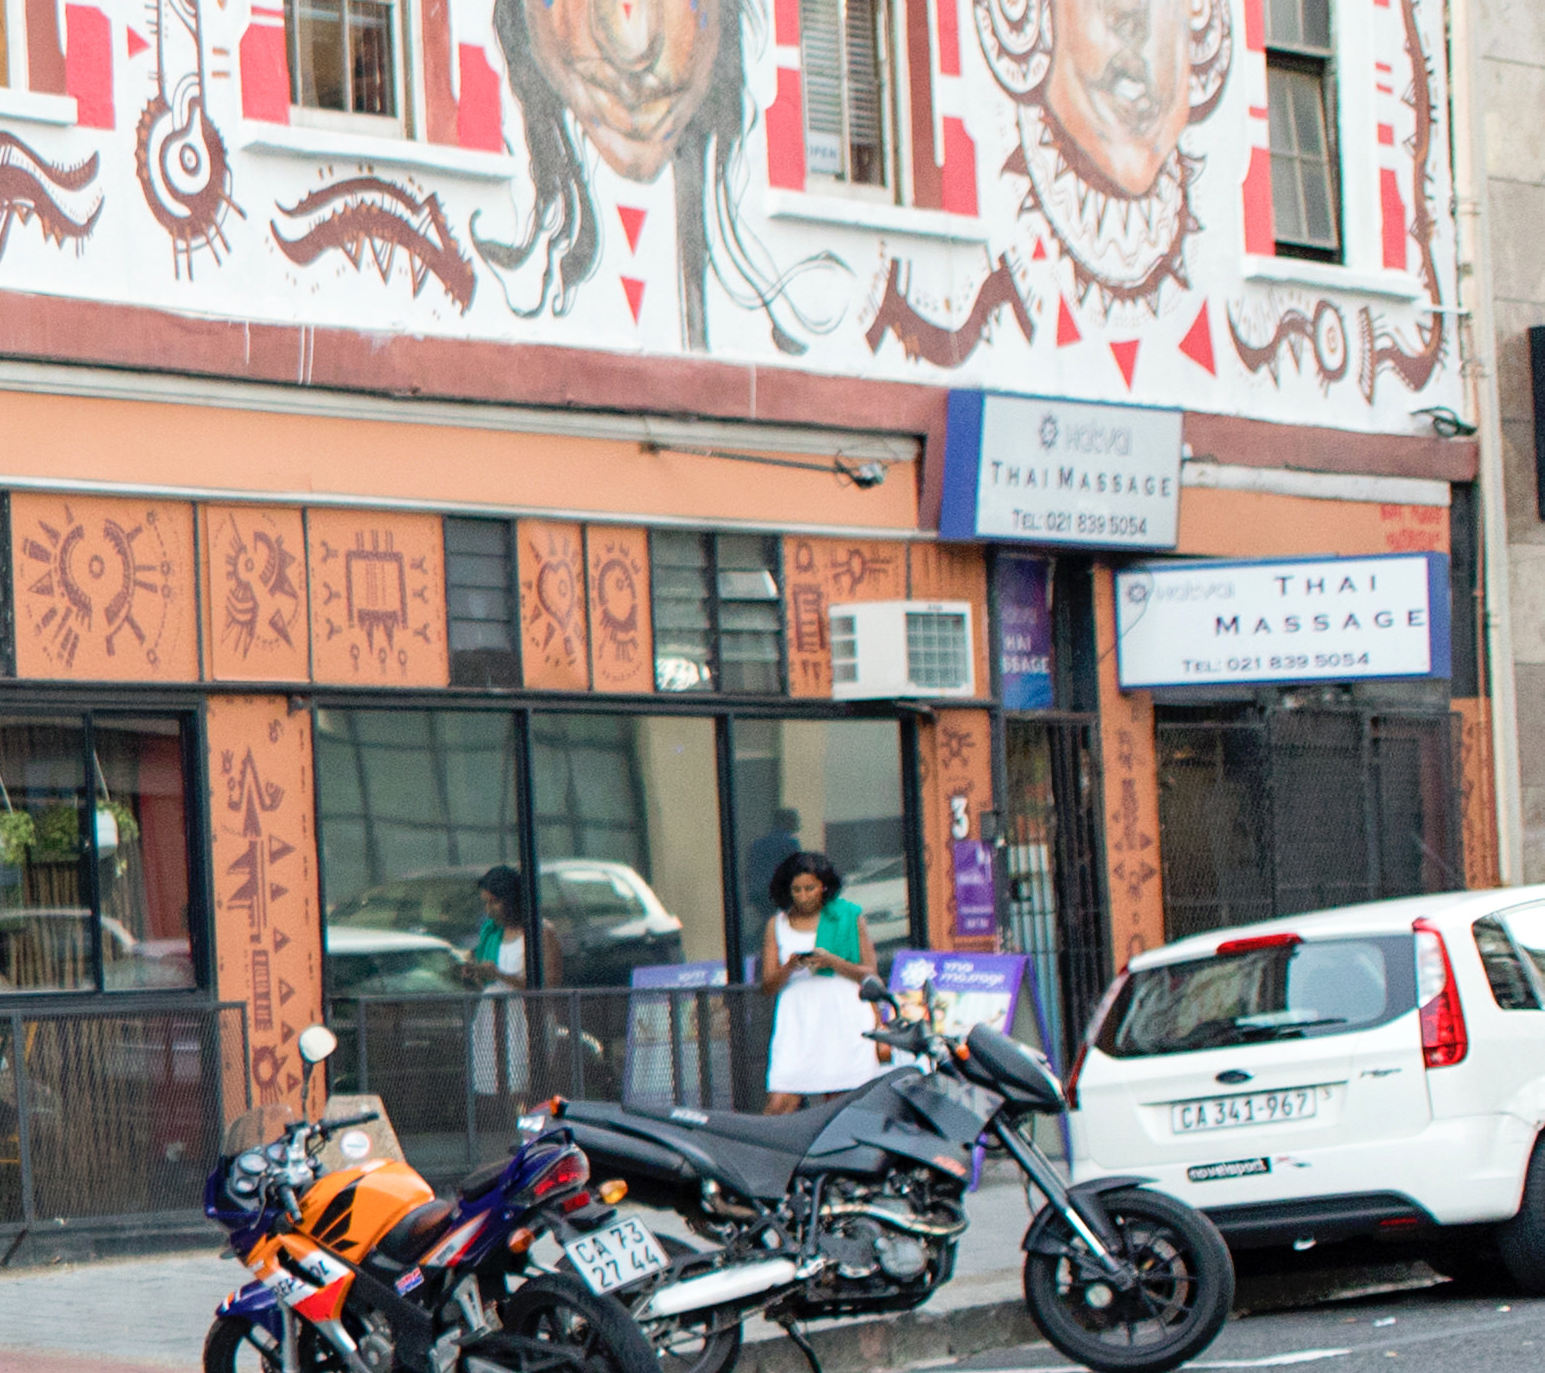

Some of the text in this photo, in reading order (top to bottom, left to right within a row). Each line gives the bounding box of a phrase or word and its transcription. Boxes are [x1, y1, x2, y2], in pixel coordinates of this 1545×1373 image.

[991, 461, 1171, 497] THAI MASSAGE
[1047, 512, 1072, 531] 021
[1077, 513, 1106, 534] 839
[1108, 514, 1147, 535] 5054
[1274, 574, 1377, 597] THAI
[1215, 609, 1425, 636] MASSAGE
[1227, 657, 1261, 672] 021
[1270, 655, 1309, 669] 839
[1315, 652, 1370, 668] 5054
[1181, 1092, 1308, 1129] CA 341-967
[575, 1221, 644, 1264] CA 73
[592, 1245, 661, 1288] 27 44
